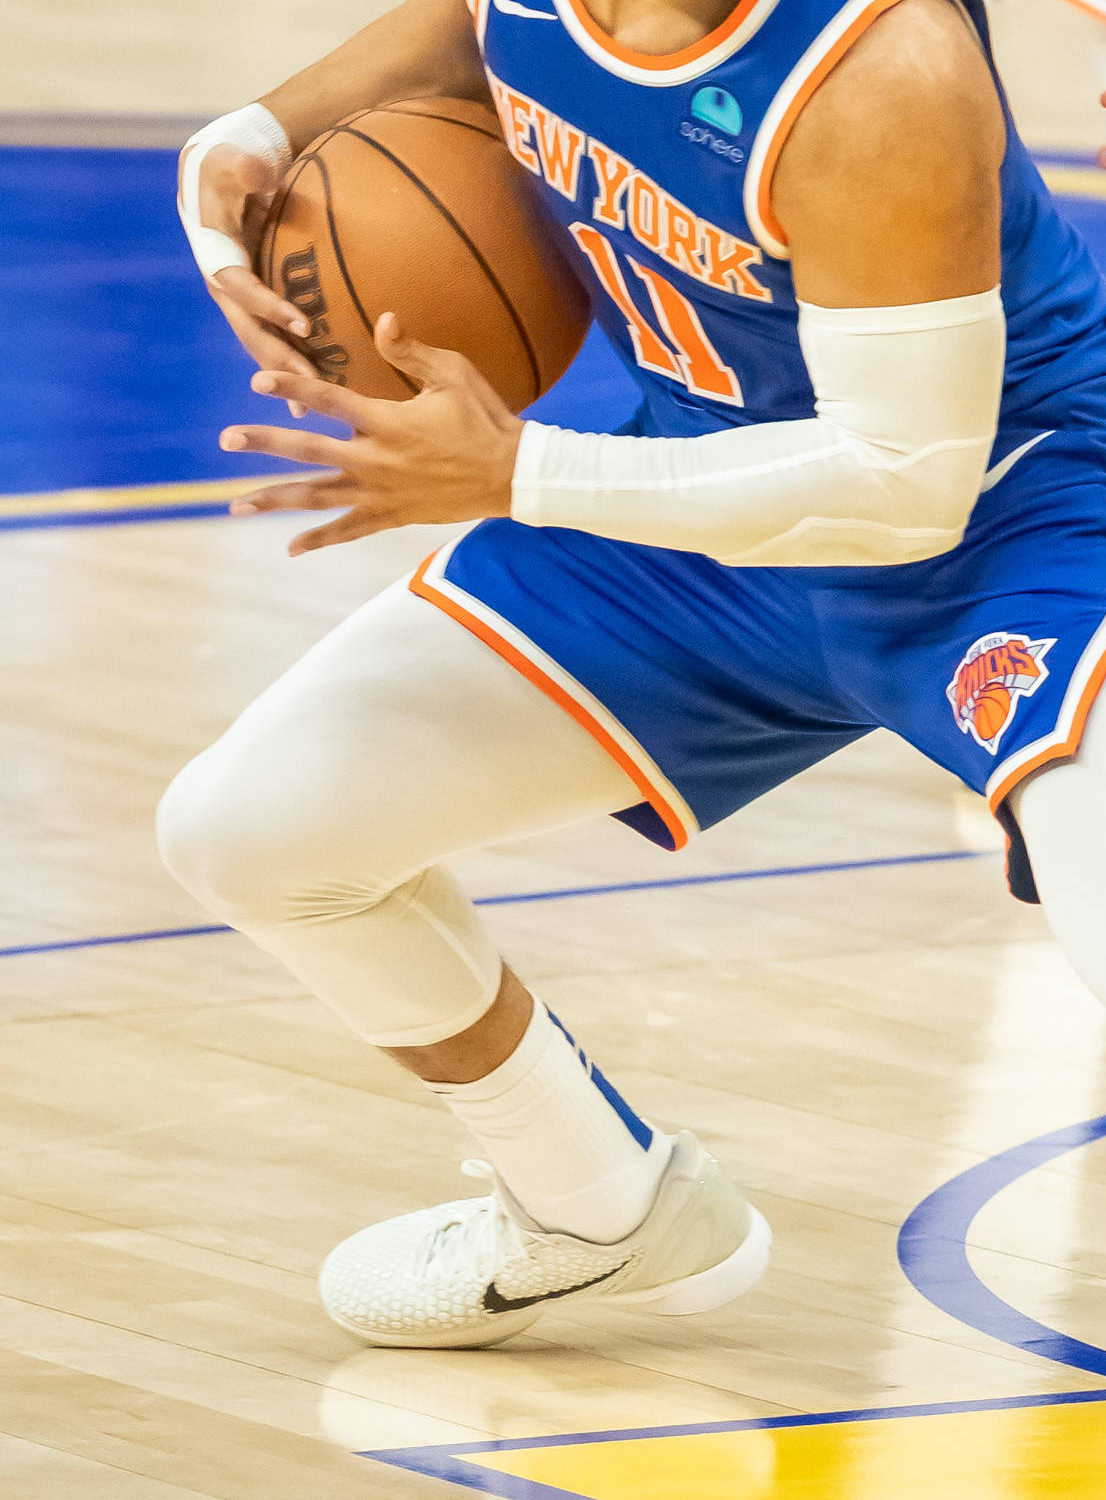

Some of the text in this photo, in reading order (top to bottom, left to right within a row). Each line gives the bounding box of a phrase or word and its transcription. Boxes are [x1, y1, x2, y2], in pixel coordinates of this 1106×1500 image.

[483, 65, 773, 304] EW YORK
[680, 121, 745, 164] sphere
[567, 221, 745, 408] 11
